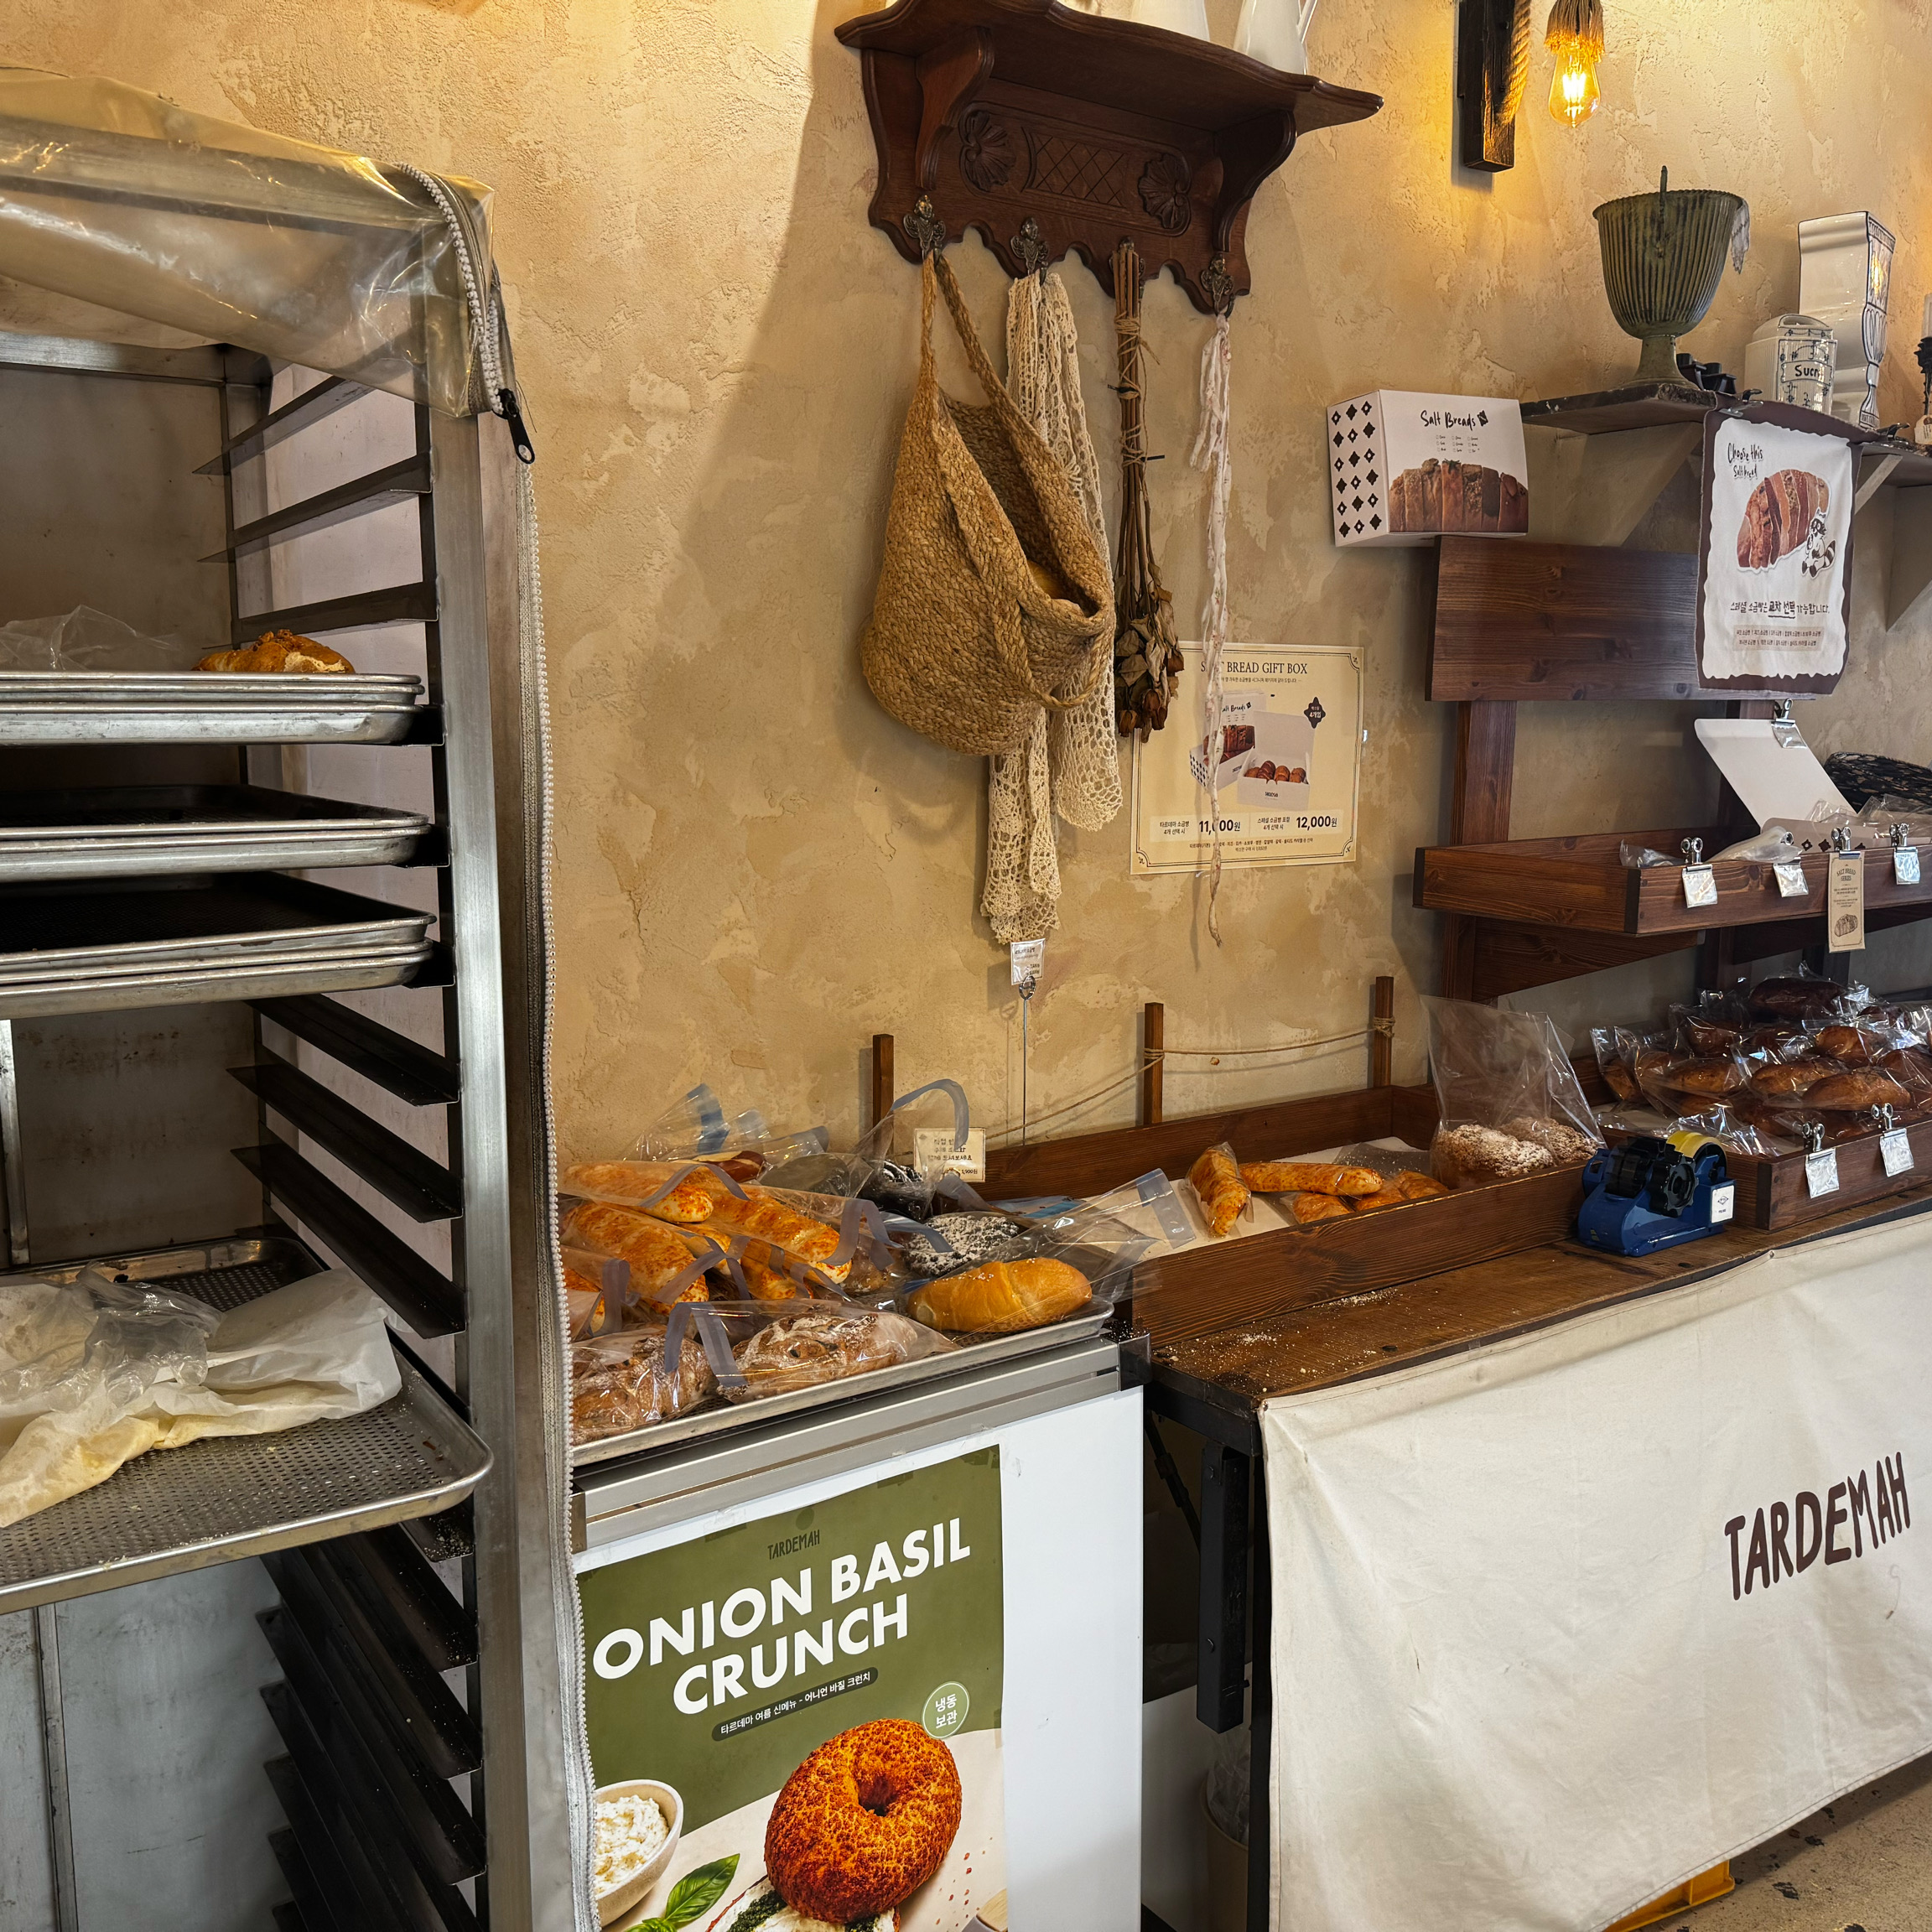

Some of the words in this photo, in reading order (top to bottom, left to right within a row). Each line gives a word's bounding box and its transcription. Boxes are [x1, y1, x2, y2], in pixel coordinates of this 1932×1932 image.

[1794, 364, 1824, 377] Sucr
[1420, 409, 1441, 427] Salt
[1445, 412, 1476, 431] Breads
[1727, 442, 1749, 464] Choose
[1750, 444, 1763, 460] this
[1783, 600, 1795, 615] 선택
[1227, 662, 1259, 673] BREAD
[1262, 662, 1285, 673] GIFT
[1287, 663, 1308, 674] BOX
[1296, 815, 1337, 831] 12,000원
[1724, 1452, 1911, 1601] TARDEMAH
[767, 1530, 820, 1560] TARDEMAH
[592, 1568, 813, 1680] ONION
[831, 1517, 971, 1604] BASIL
[673, 1593, 908, 1715] CRUNCH
[720, 1715, 754, 1734] 타르데마
[755, 1708, 771, 1721] 여름
[773, 1700, 797, 1715] 신메뉴
[804, 1686, 828, 1702] 어니언
[829, 1680, 845, 1692] 바질
[847, 1671, 870, 1688] 크런치
[935, 1694, 958, 1712] 냉동
[935, 1710, 958, 1729] 보관
